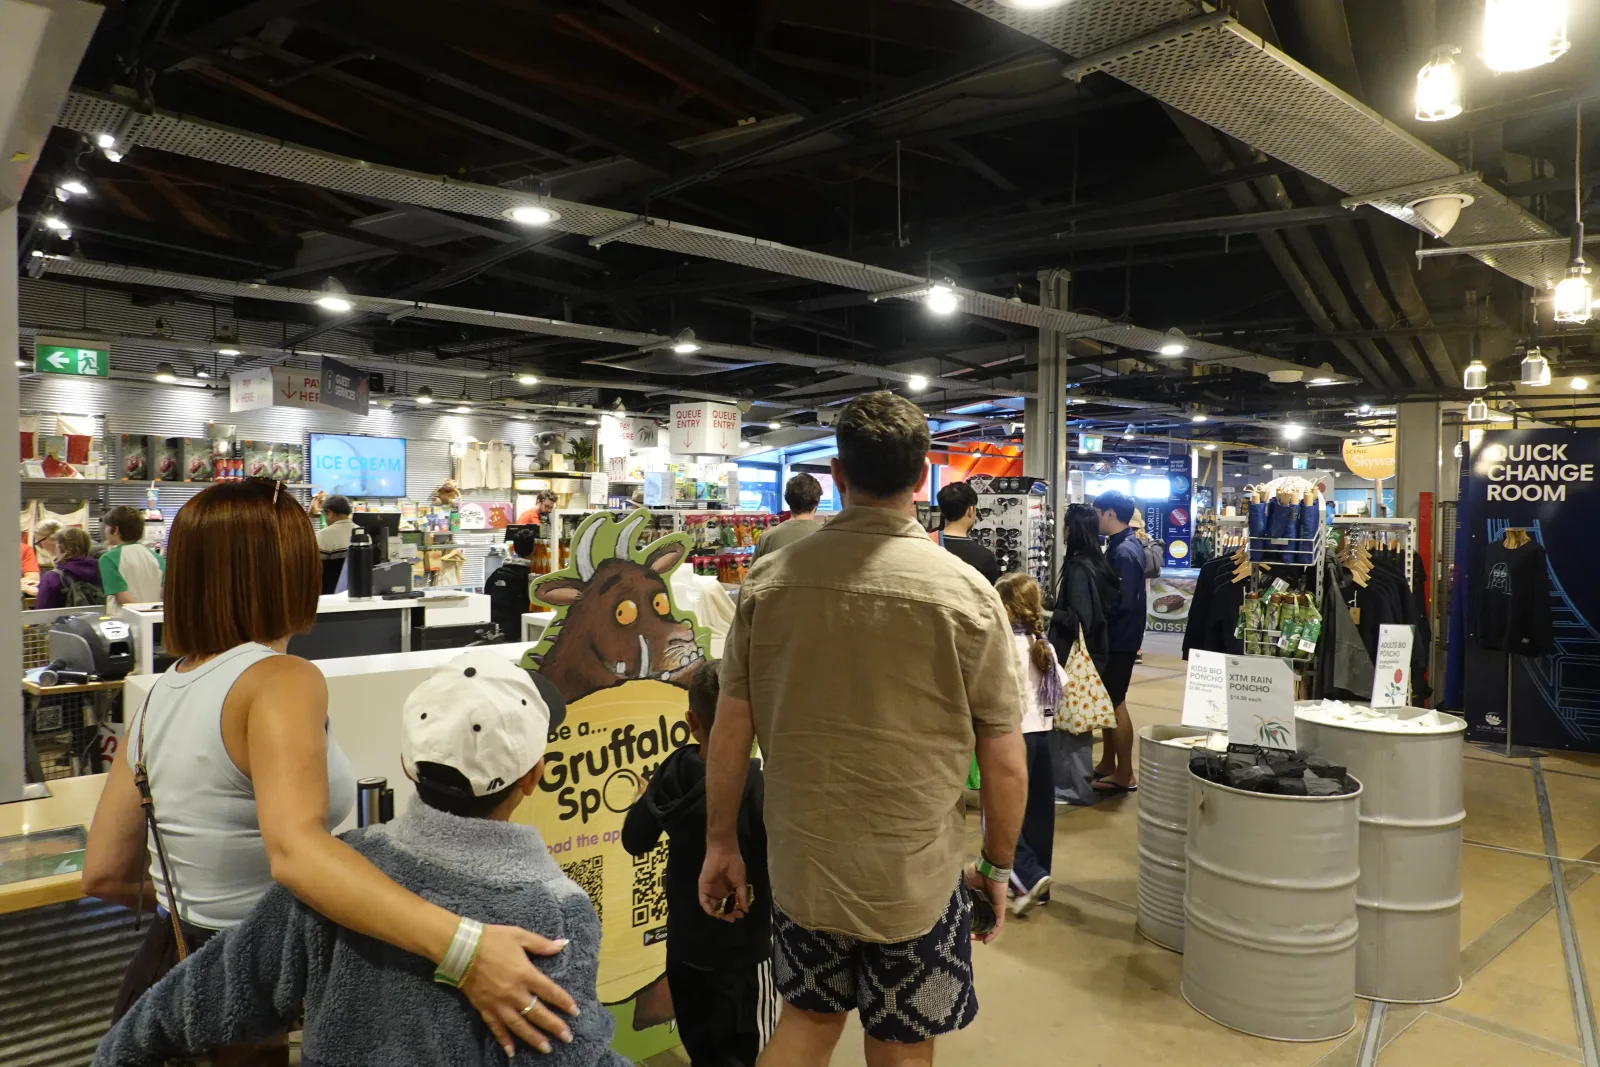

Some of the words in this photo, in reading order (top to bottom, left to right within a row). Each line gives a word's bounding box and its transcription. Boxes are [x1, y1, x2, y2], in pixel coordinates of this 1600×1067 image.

[335, 374, 351, 387] GUEST
[334, 386, 356, 400] SERVICES
[676, 409, 702, 420] QUEUE
[712, 410, 737, 421] QUEUE
[619, 422, 632, 431] PAY
[677, 419, 701, 429] ENTRY
[713, 420, 736, 429] ENTRY
[1487, 444, 1569, 461] QUICK
[316, 455, 342, 470] ICE
[347, 456, 401, 472] CREAM
[1352, 454, 1395, 471] Skywa
[1487, 464, 1594, 482] CHANGE
[1487, 484, 1566, 502] ROOM
[1191, 665, 1208, 673] KIDS
[1209, 667, 1223, 675] BIO
[1190, 673, 1224, 683] PONCHO
[1229, 674, 1248, 683] XTM
[1250, 675, 1273, 684] RAIN
[1229, 683, 1270, 693] PONCHO
[538, 715, 691, 792] Gruffalo
[576, 833, 599, 848] the
